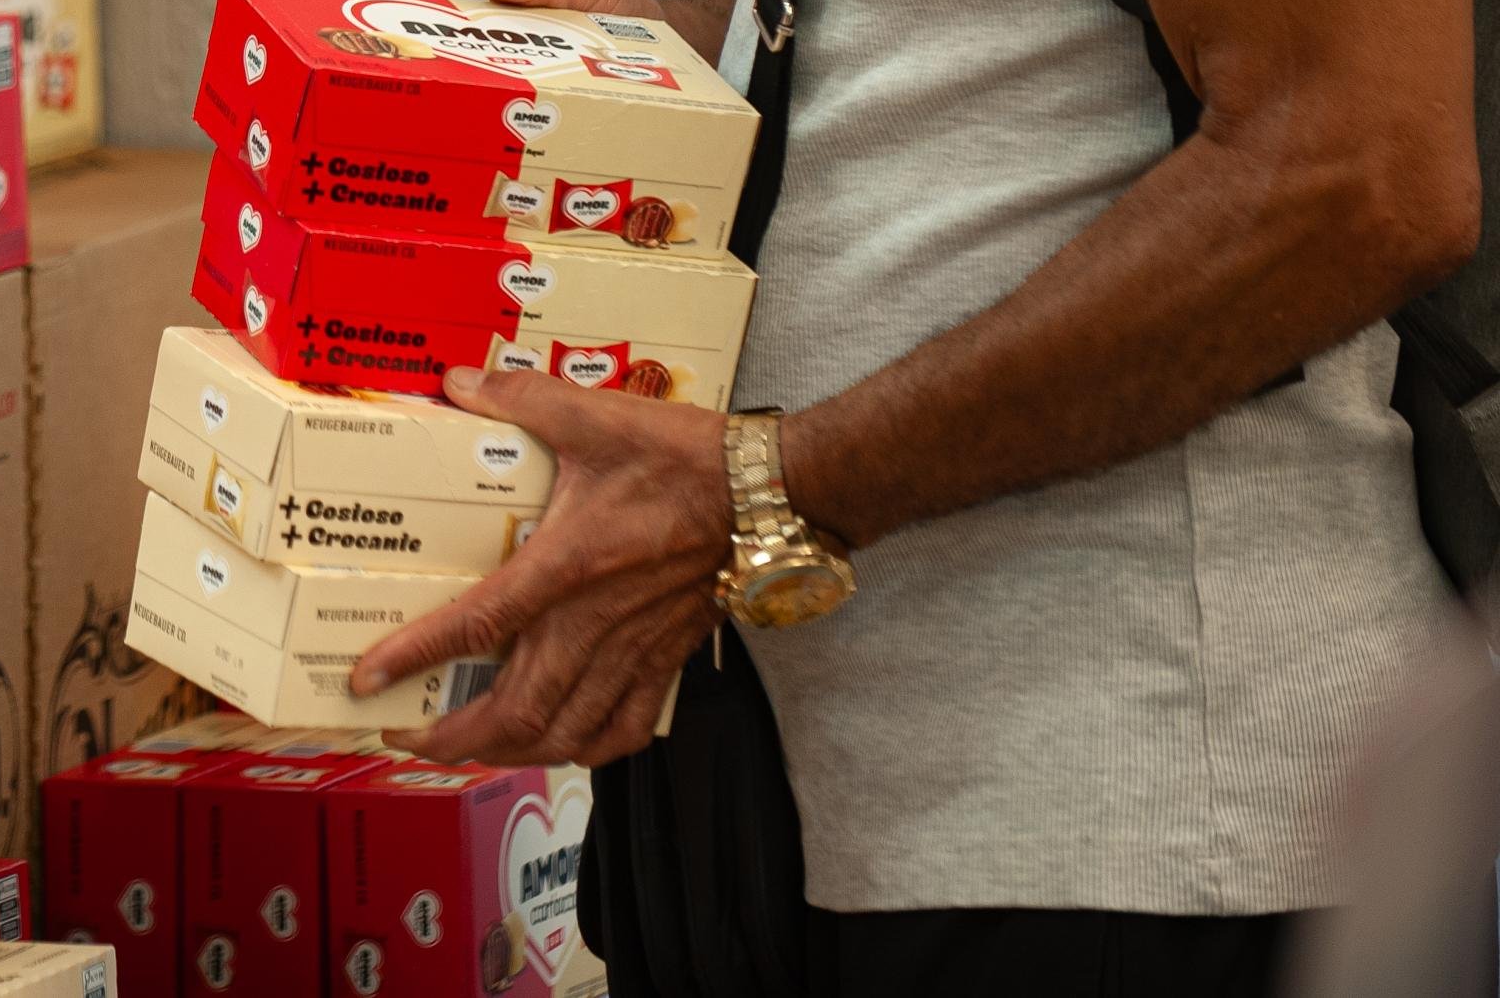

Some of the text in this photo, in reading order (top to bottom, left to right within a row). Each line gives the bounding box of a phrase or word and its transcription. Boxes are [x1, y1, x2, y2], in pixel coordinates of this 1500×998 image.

[400, 20, 576, 51] AMOR
[440, 38, 558, 59] carioca
[329, 74, 402, 93] NEUGEBAUER
[513, 112, 551, 124] AMOR
[251, 131, 267, 156] AMOR
[328, 157, 431, 185] Gostoso
[330, 184, 449, 213] Crocante
[506, 193, 537, 206] AMOR
[572, 200, 610, 211] AMOR
[510, 275, 547, 287] AMOR
[324, 319, 427, 347] Gostoso
[327, 346, 447, 375] Crocante
[504, 356, 535, 369] AMOR
[570, 362, 607, 374] AMOR
[205, 400, 224, 418] AMOR
[306, 418, 395, 436] NEUGEBAUER CO.
[150, 439, 187, 474] NEUGEBAUER
[483, 447, 519, 459] AMOR
[218, 484, 237, 505] AMOR
[306, 499, 404, 525] Gostoso
[308, 527, 422, 553] Crocante
[202, 563, 224, 583] AMOR
[134, 601, 176, 637] NEUGEBAUER
[316, 608, 386, 624] NEUGEBAUER
